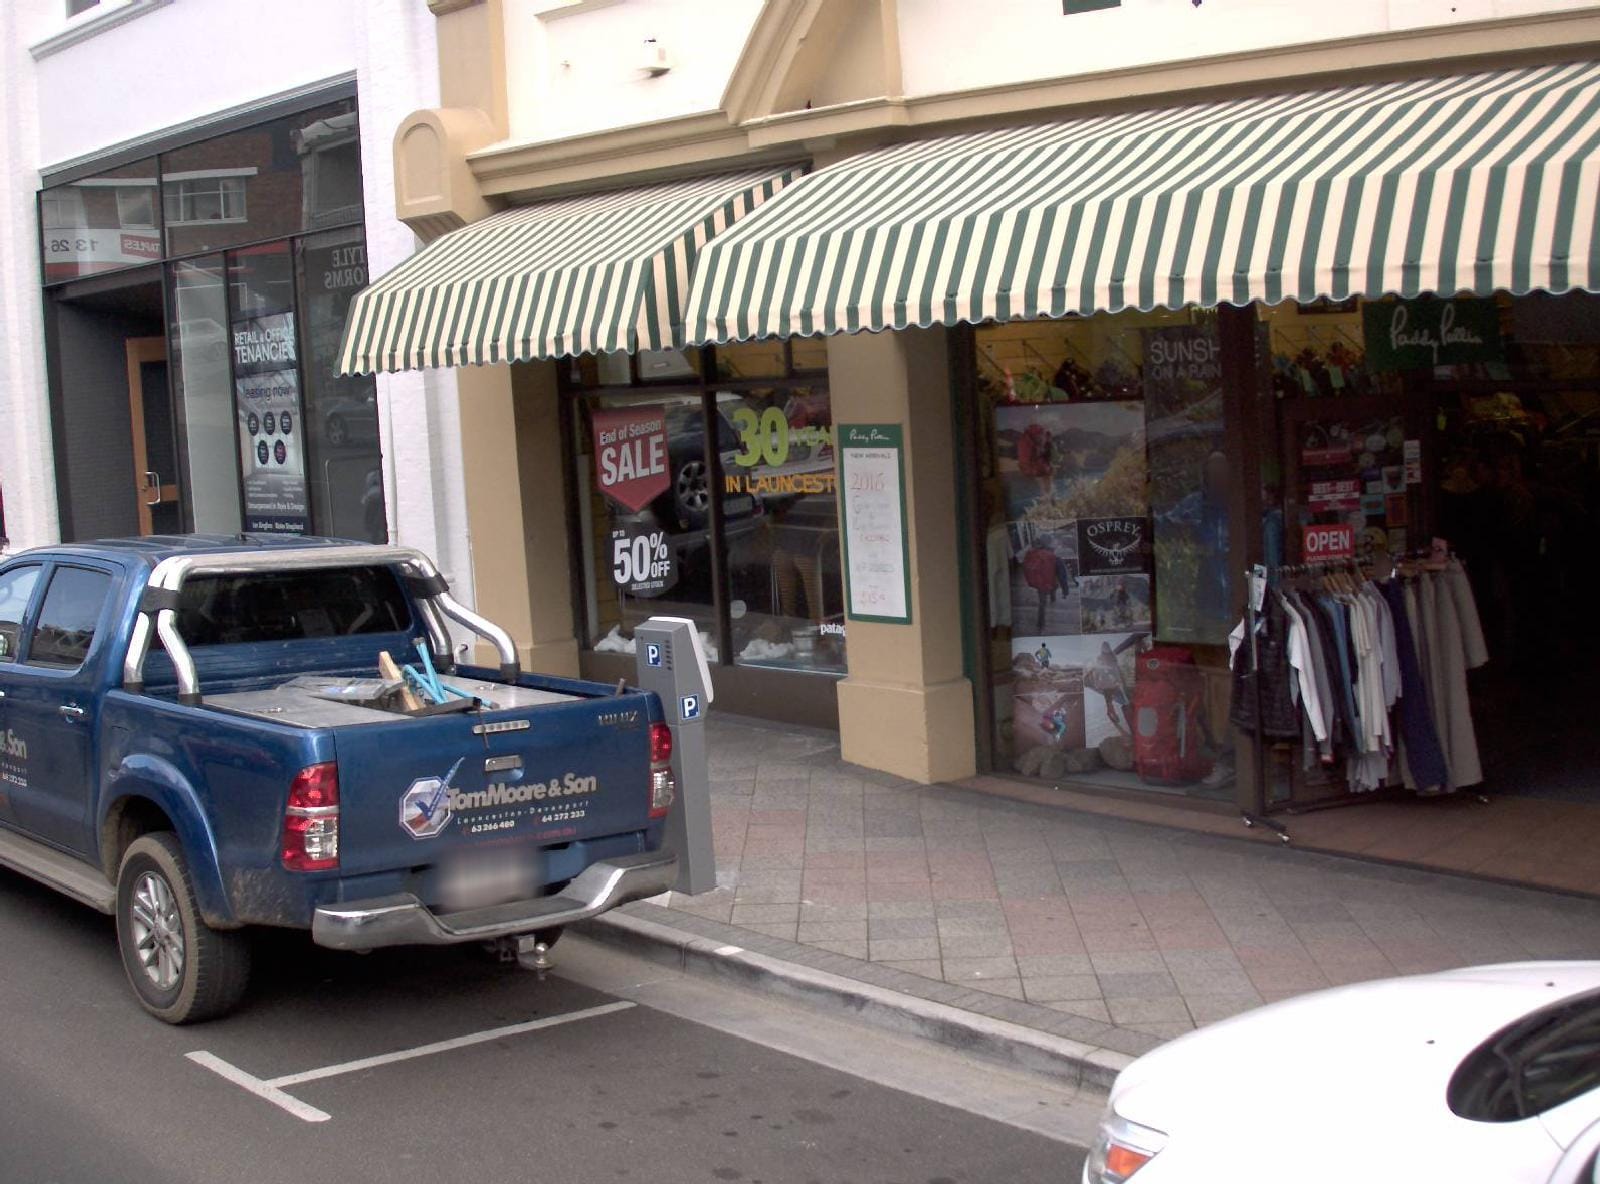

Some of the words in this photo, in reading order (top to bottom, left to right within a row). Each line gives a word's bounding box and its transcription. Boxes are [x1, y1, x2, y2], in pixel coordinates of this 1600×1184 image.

[234, 331, 259, 345] RETAIL
[600, 428, 617, 446] End
[618, 424, 628, 441] of
[628, 420, 662, 437] Season
[733, 406, 789, 468] 30
[601, 434, 665, 486] SALE
[725, 475, 741, 493] IN
[1087, 521, 1141, 537] OSPREY
[1306, 530, 1350, 552] OPEN
[614, 531, 668, 584] 50%
[650, 560, 670, 578] OFF
[647, 645, 659, 664] P
[683, 697, 696, 717] P
[548, 778, 562, 797] &
[562, 772, 597, 794] Son
